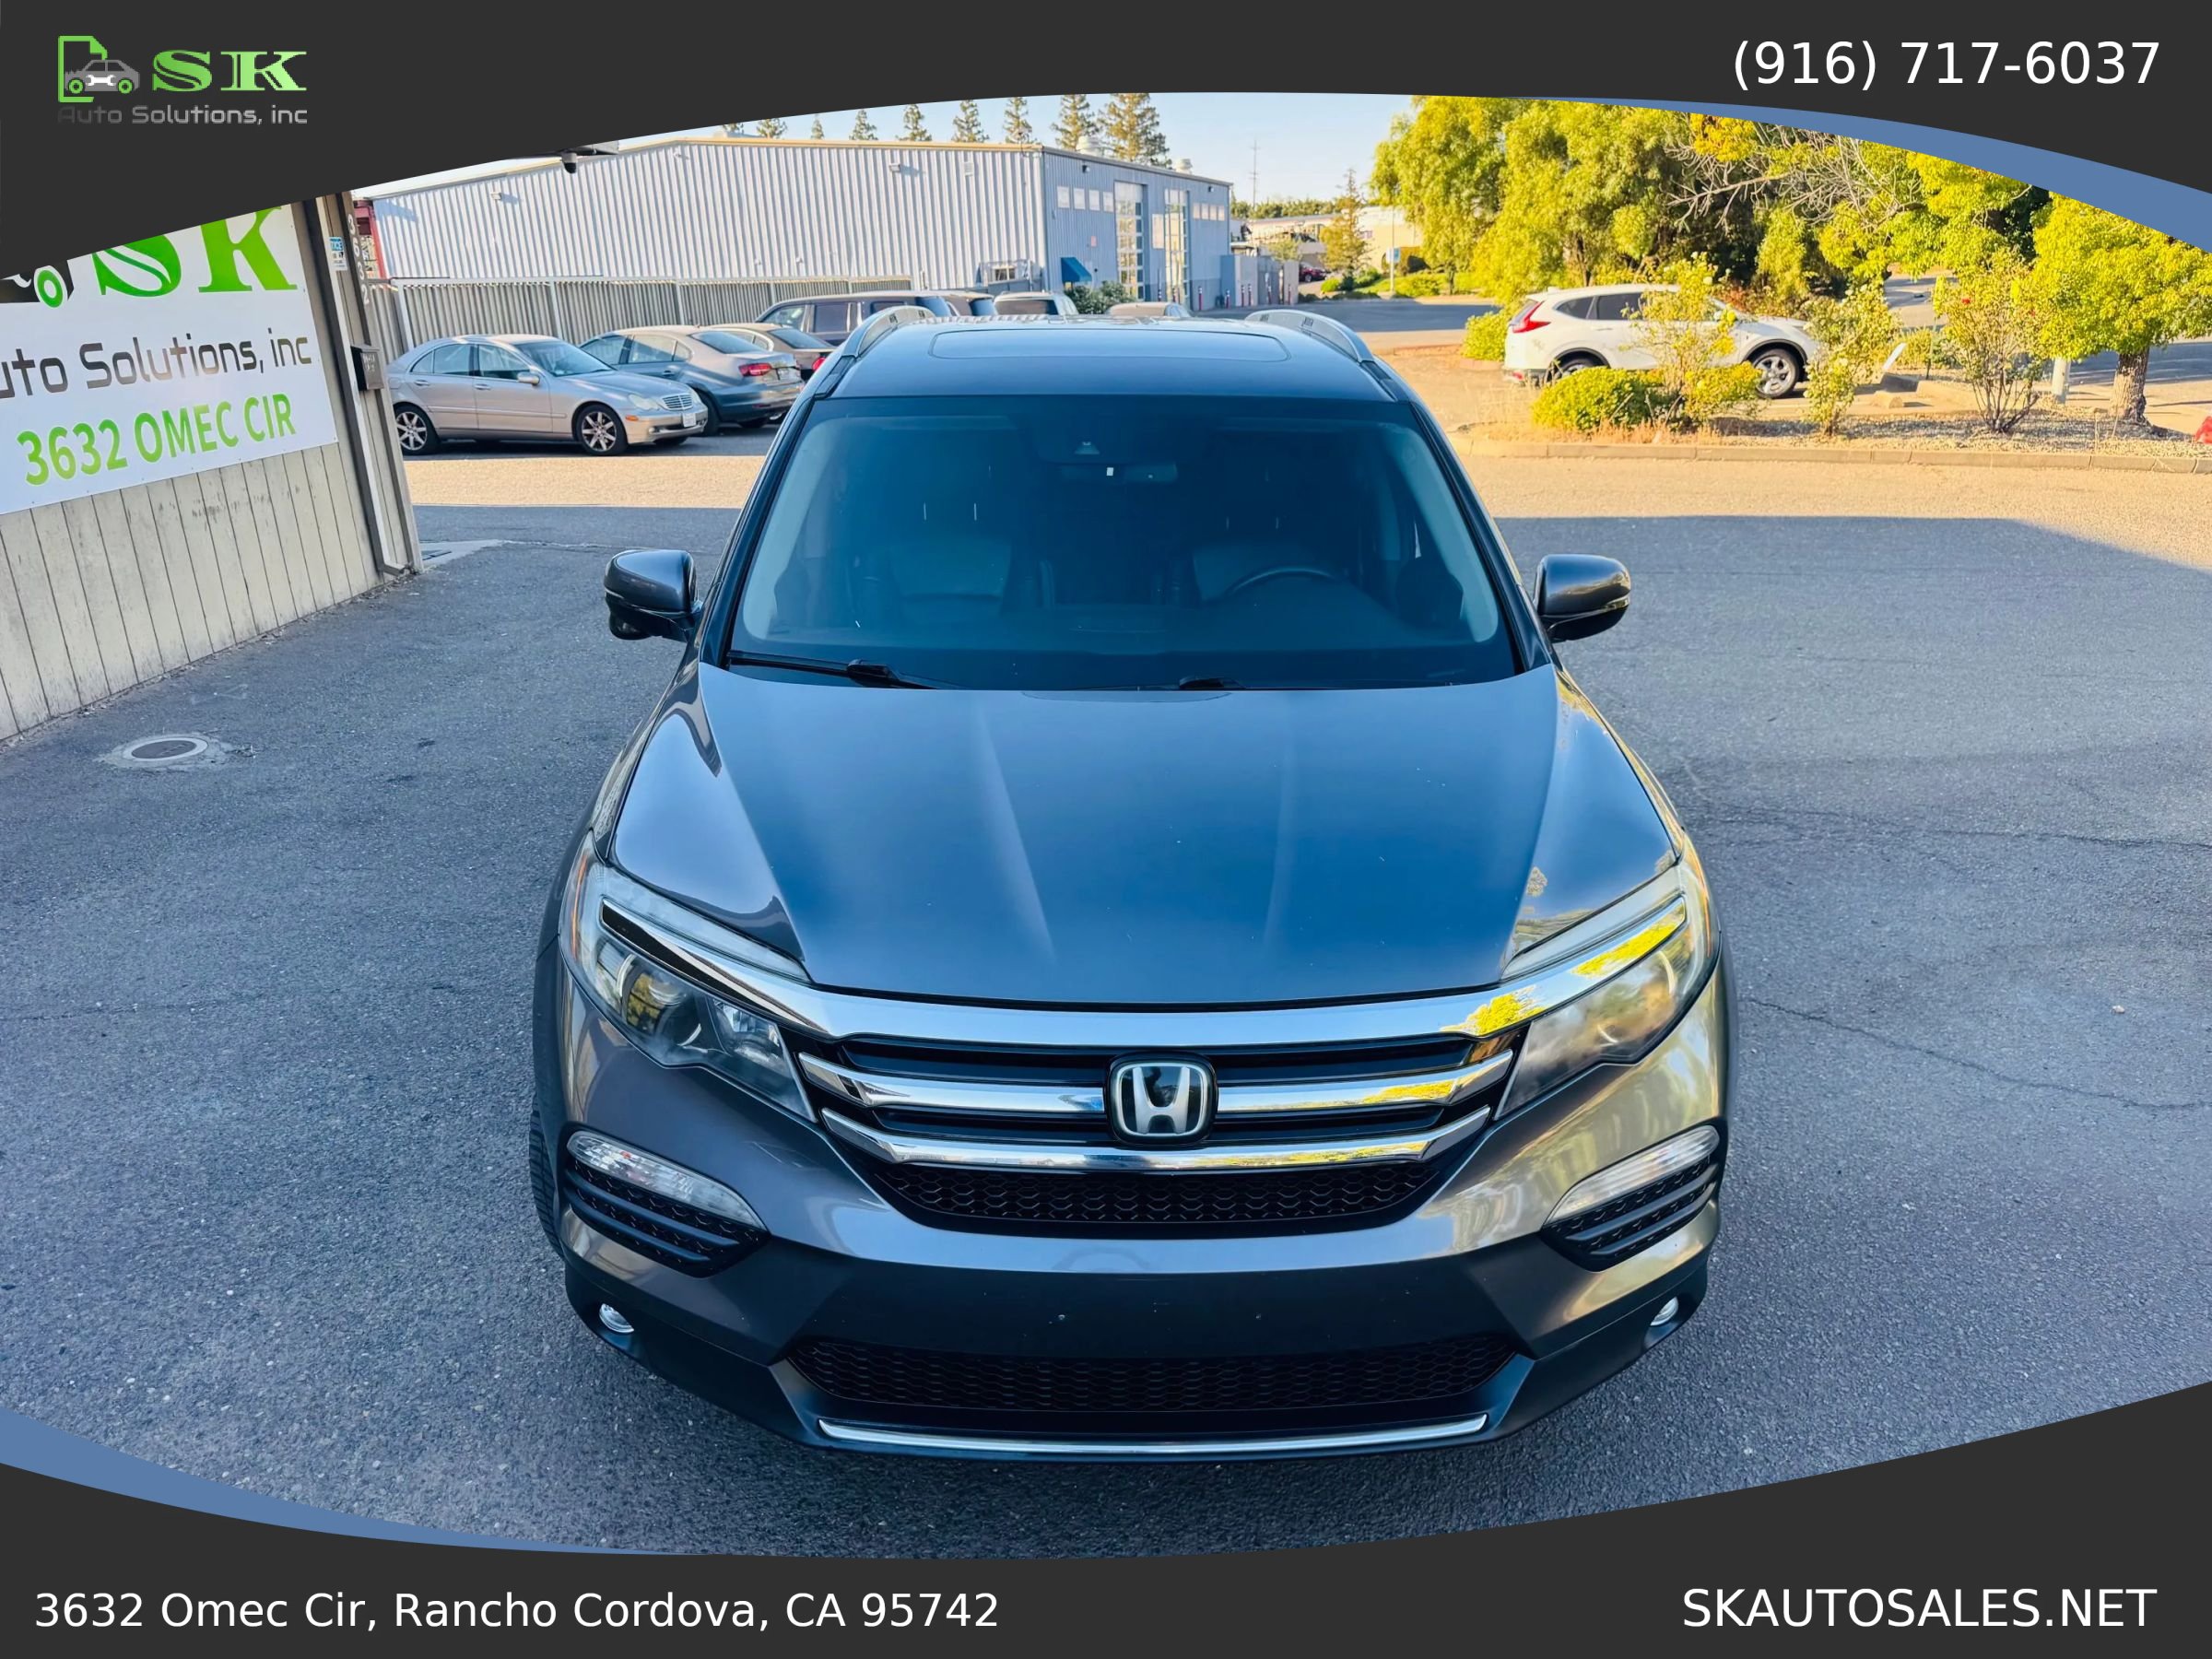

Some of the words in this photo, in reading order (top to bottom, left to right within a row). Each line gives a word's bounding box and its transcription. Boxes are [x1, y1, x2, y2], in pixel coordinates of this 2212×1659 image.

[79, 333, 265, 390] Solutions,
[267, 327, 312, 368] inc
[16, 418, 129, 487] 3632
[133, 400, 240, 464] OMEC
[242, 393, 298, 442] CIR
